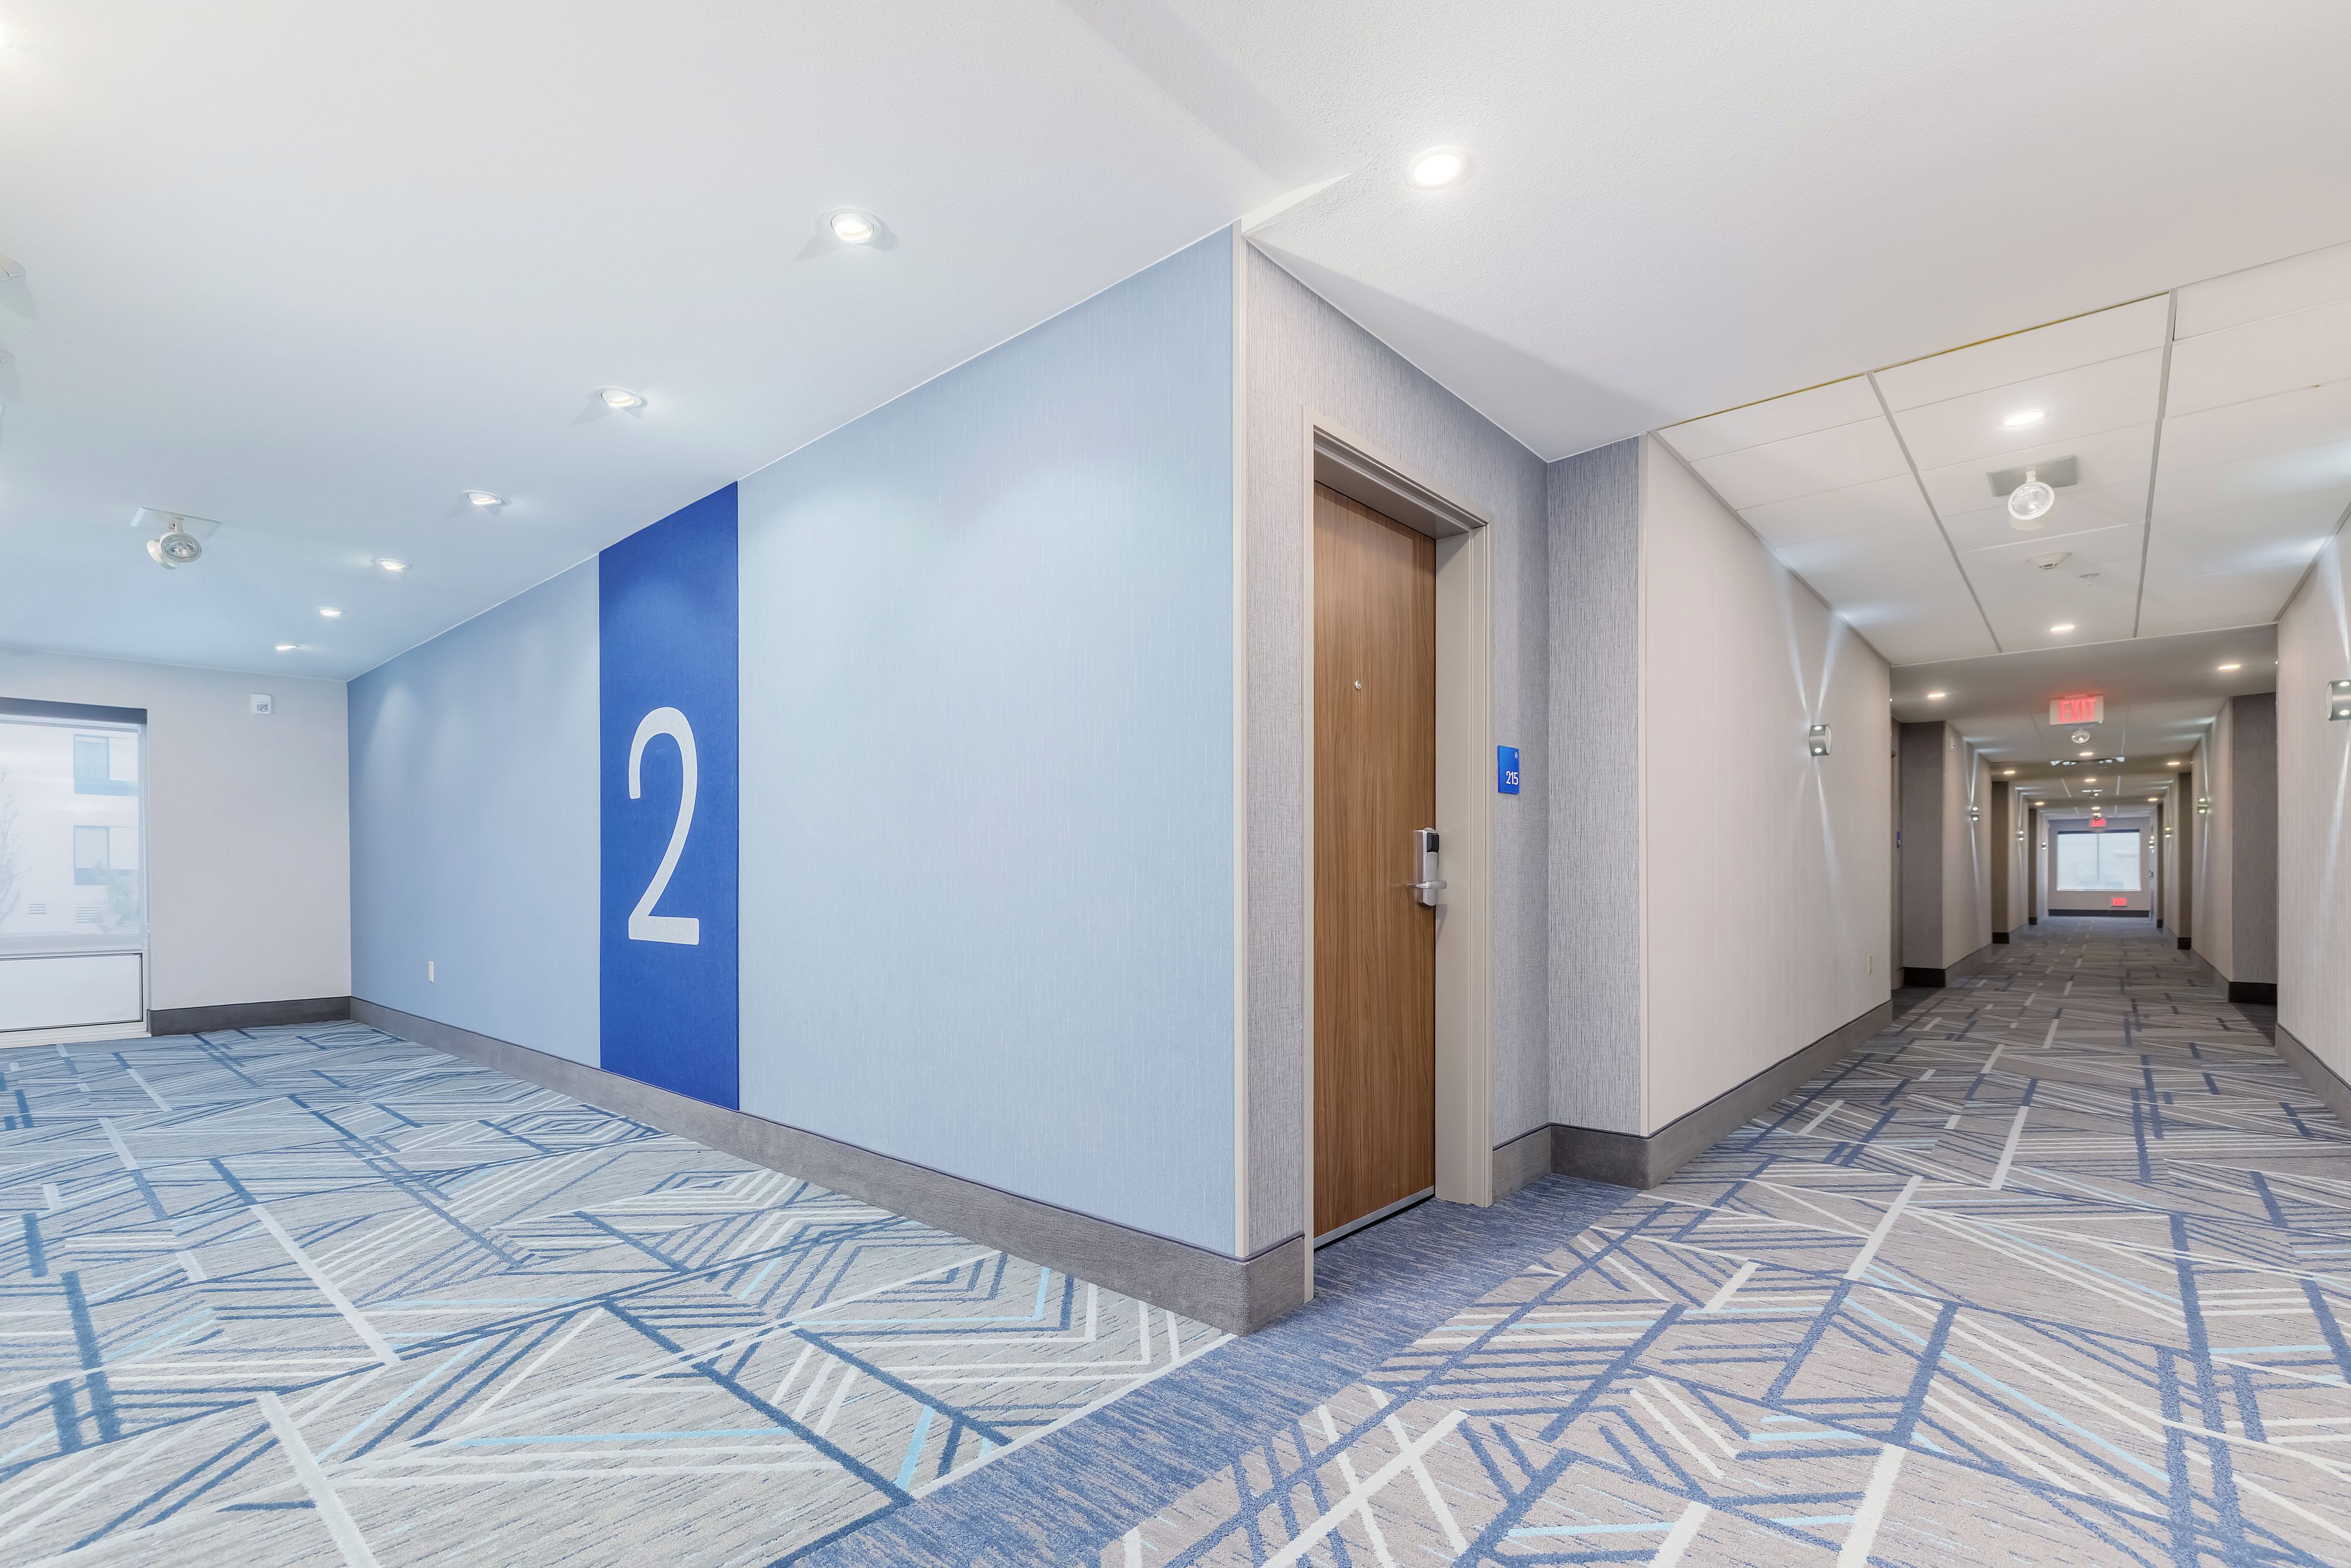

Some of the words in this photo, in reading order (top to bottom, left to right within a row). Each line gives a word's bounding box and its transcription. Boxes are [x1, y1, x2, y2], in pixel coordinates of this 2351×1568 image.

[2059, 698, 2096, 722] EXIT
[1506, 771, 1518, 785] 215
[628, 707, 699, 945] 2
